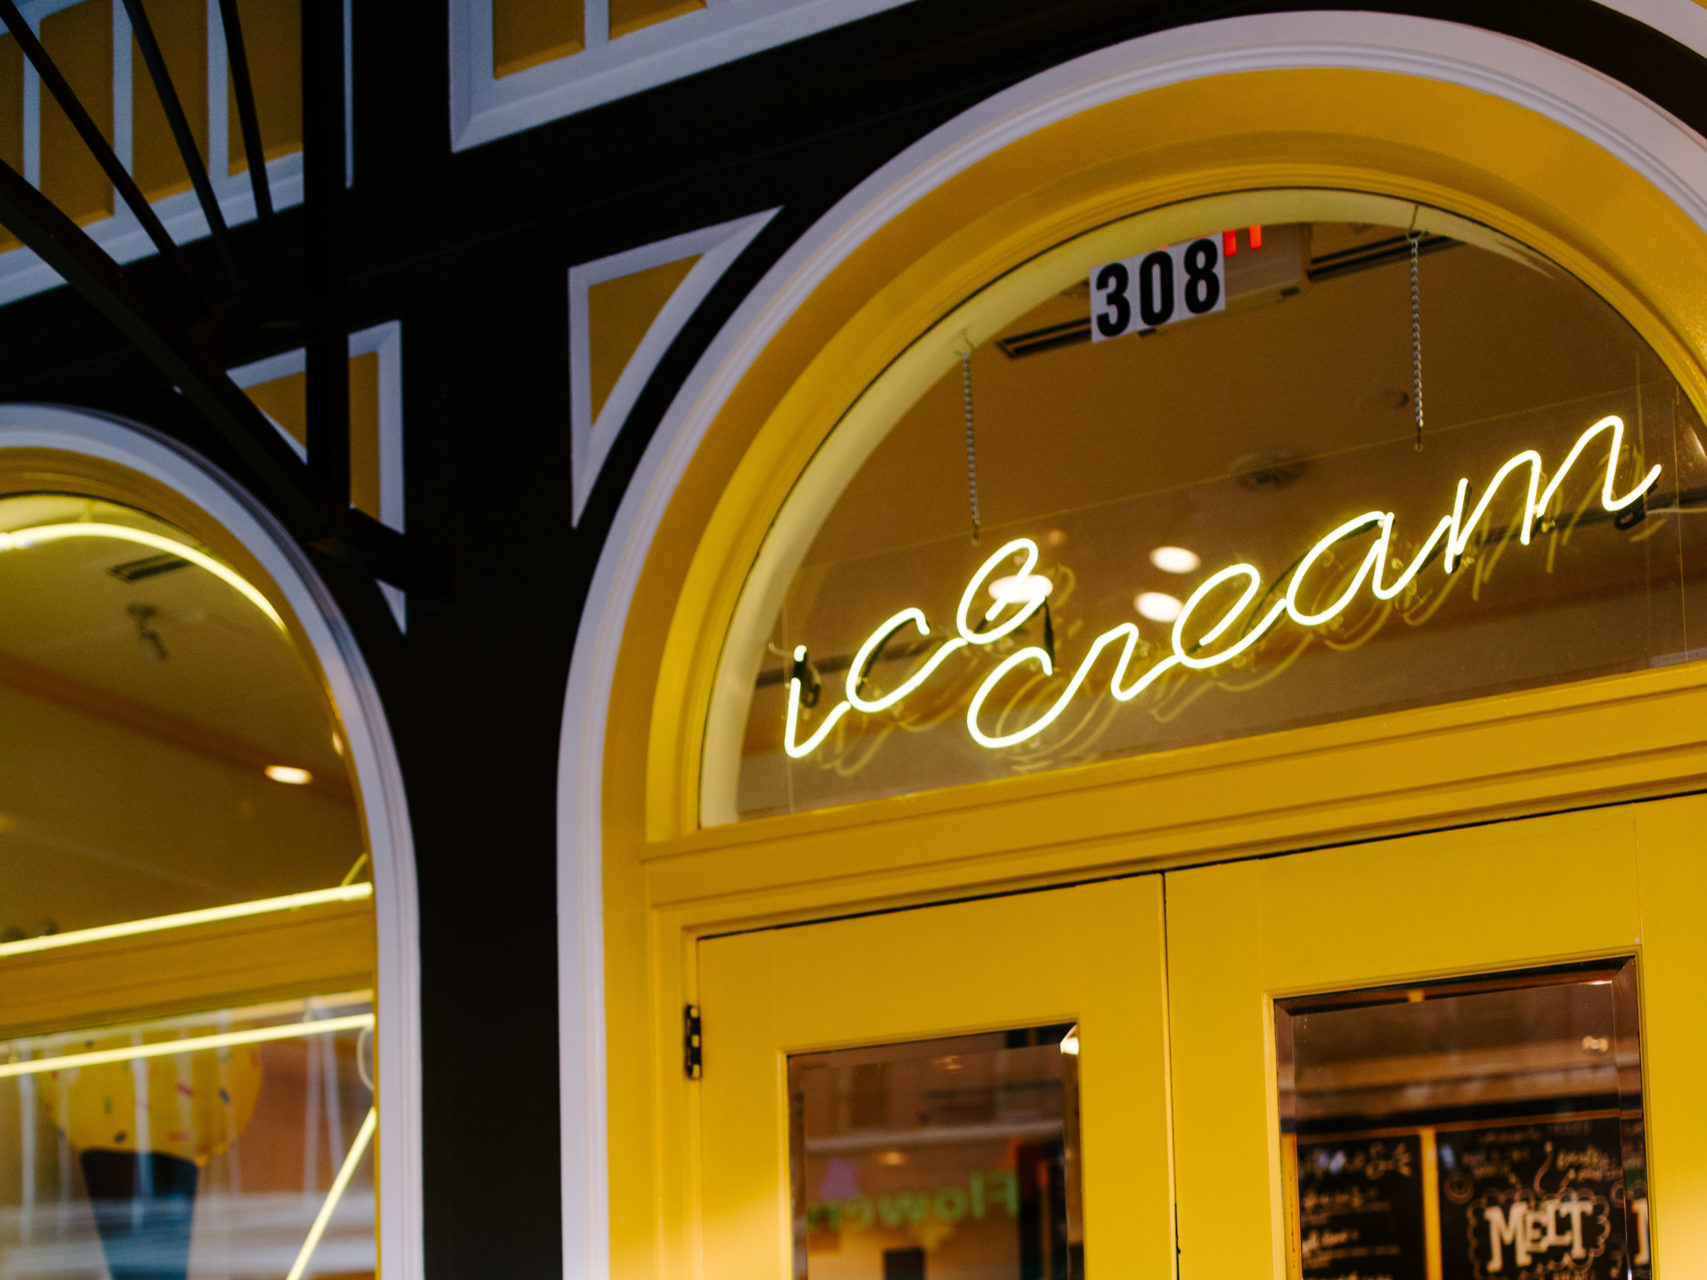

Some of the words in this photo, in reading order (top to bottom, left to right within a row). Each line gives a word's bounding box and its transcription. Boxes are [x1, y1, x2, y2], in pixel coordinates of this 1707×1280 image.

[1096, 238, 1221, 338] 308
[784, 537, 1048, 759] ice
[966, 414, 1663, 750] cream
[1483, 1198, 1595, 1274] MELT
